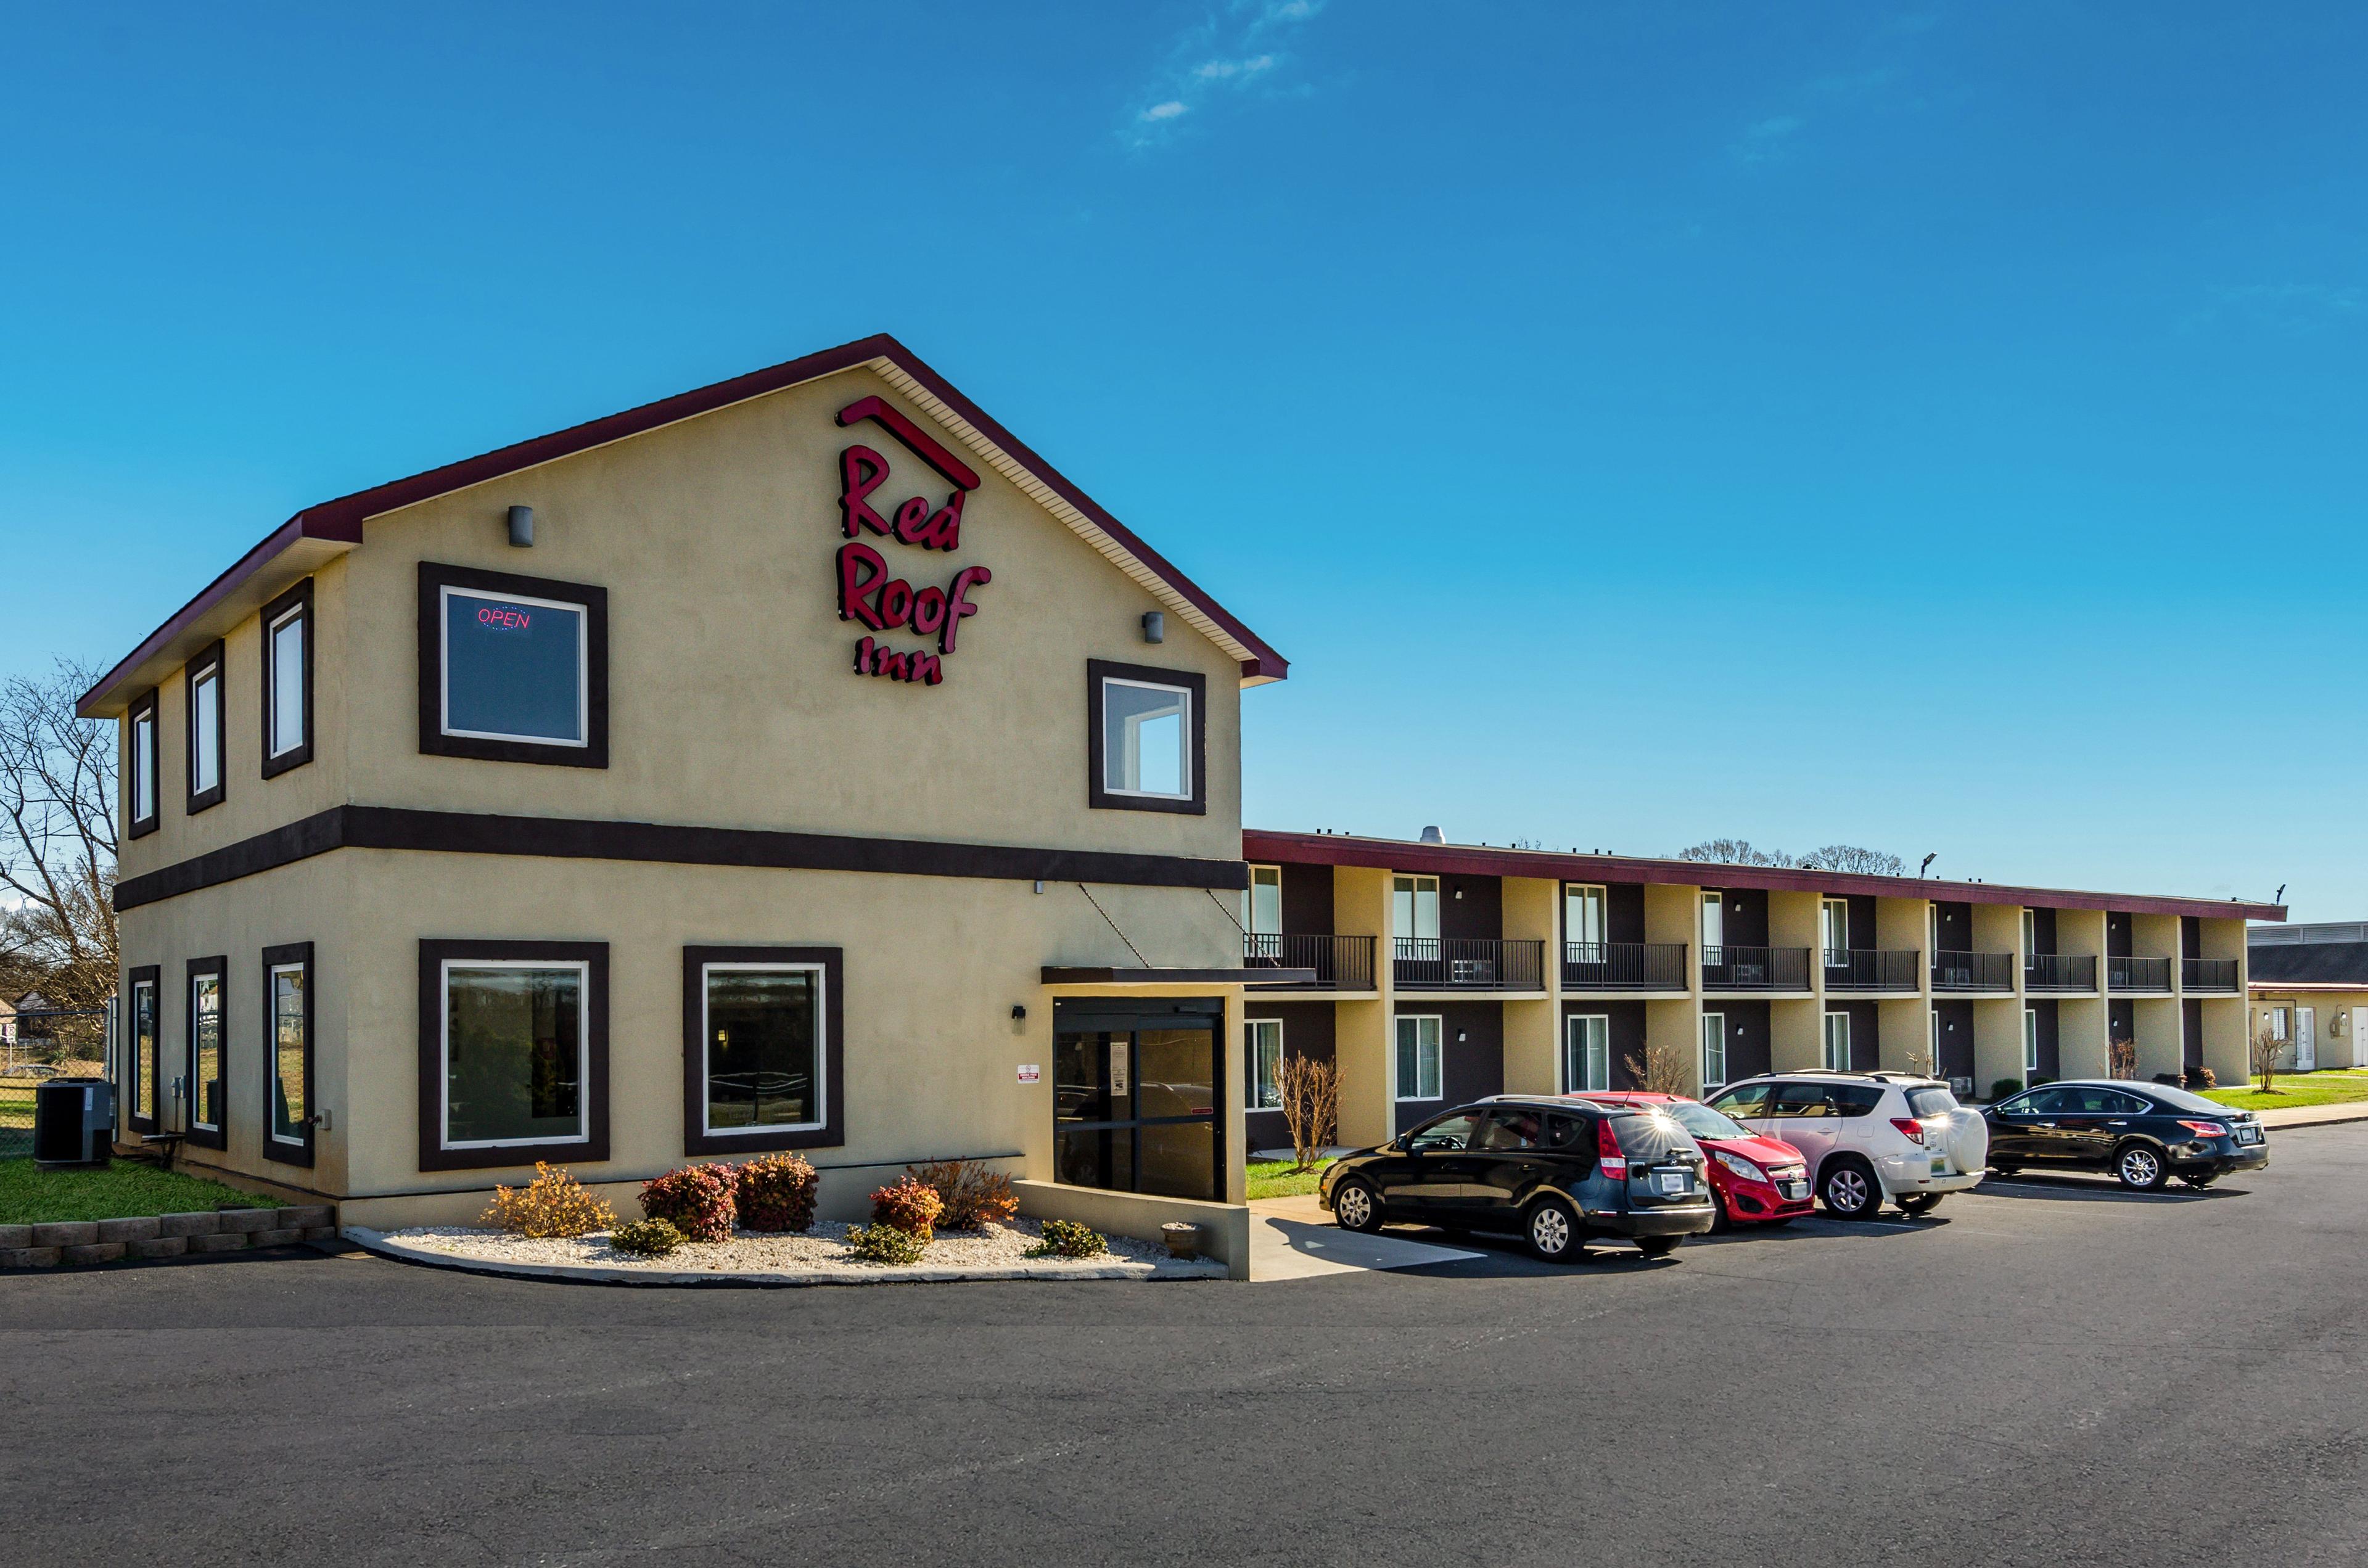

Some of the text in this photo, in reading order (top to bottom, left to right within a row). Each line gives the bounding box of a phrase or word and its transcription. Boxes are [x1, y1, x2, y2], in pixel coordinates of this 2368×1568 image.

[838, 445, 965, 551] Red
[478, 608, 530, 629] OPEN
[836, 542, 992, 655] Roof
